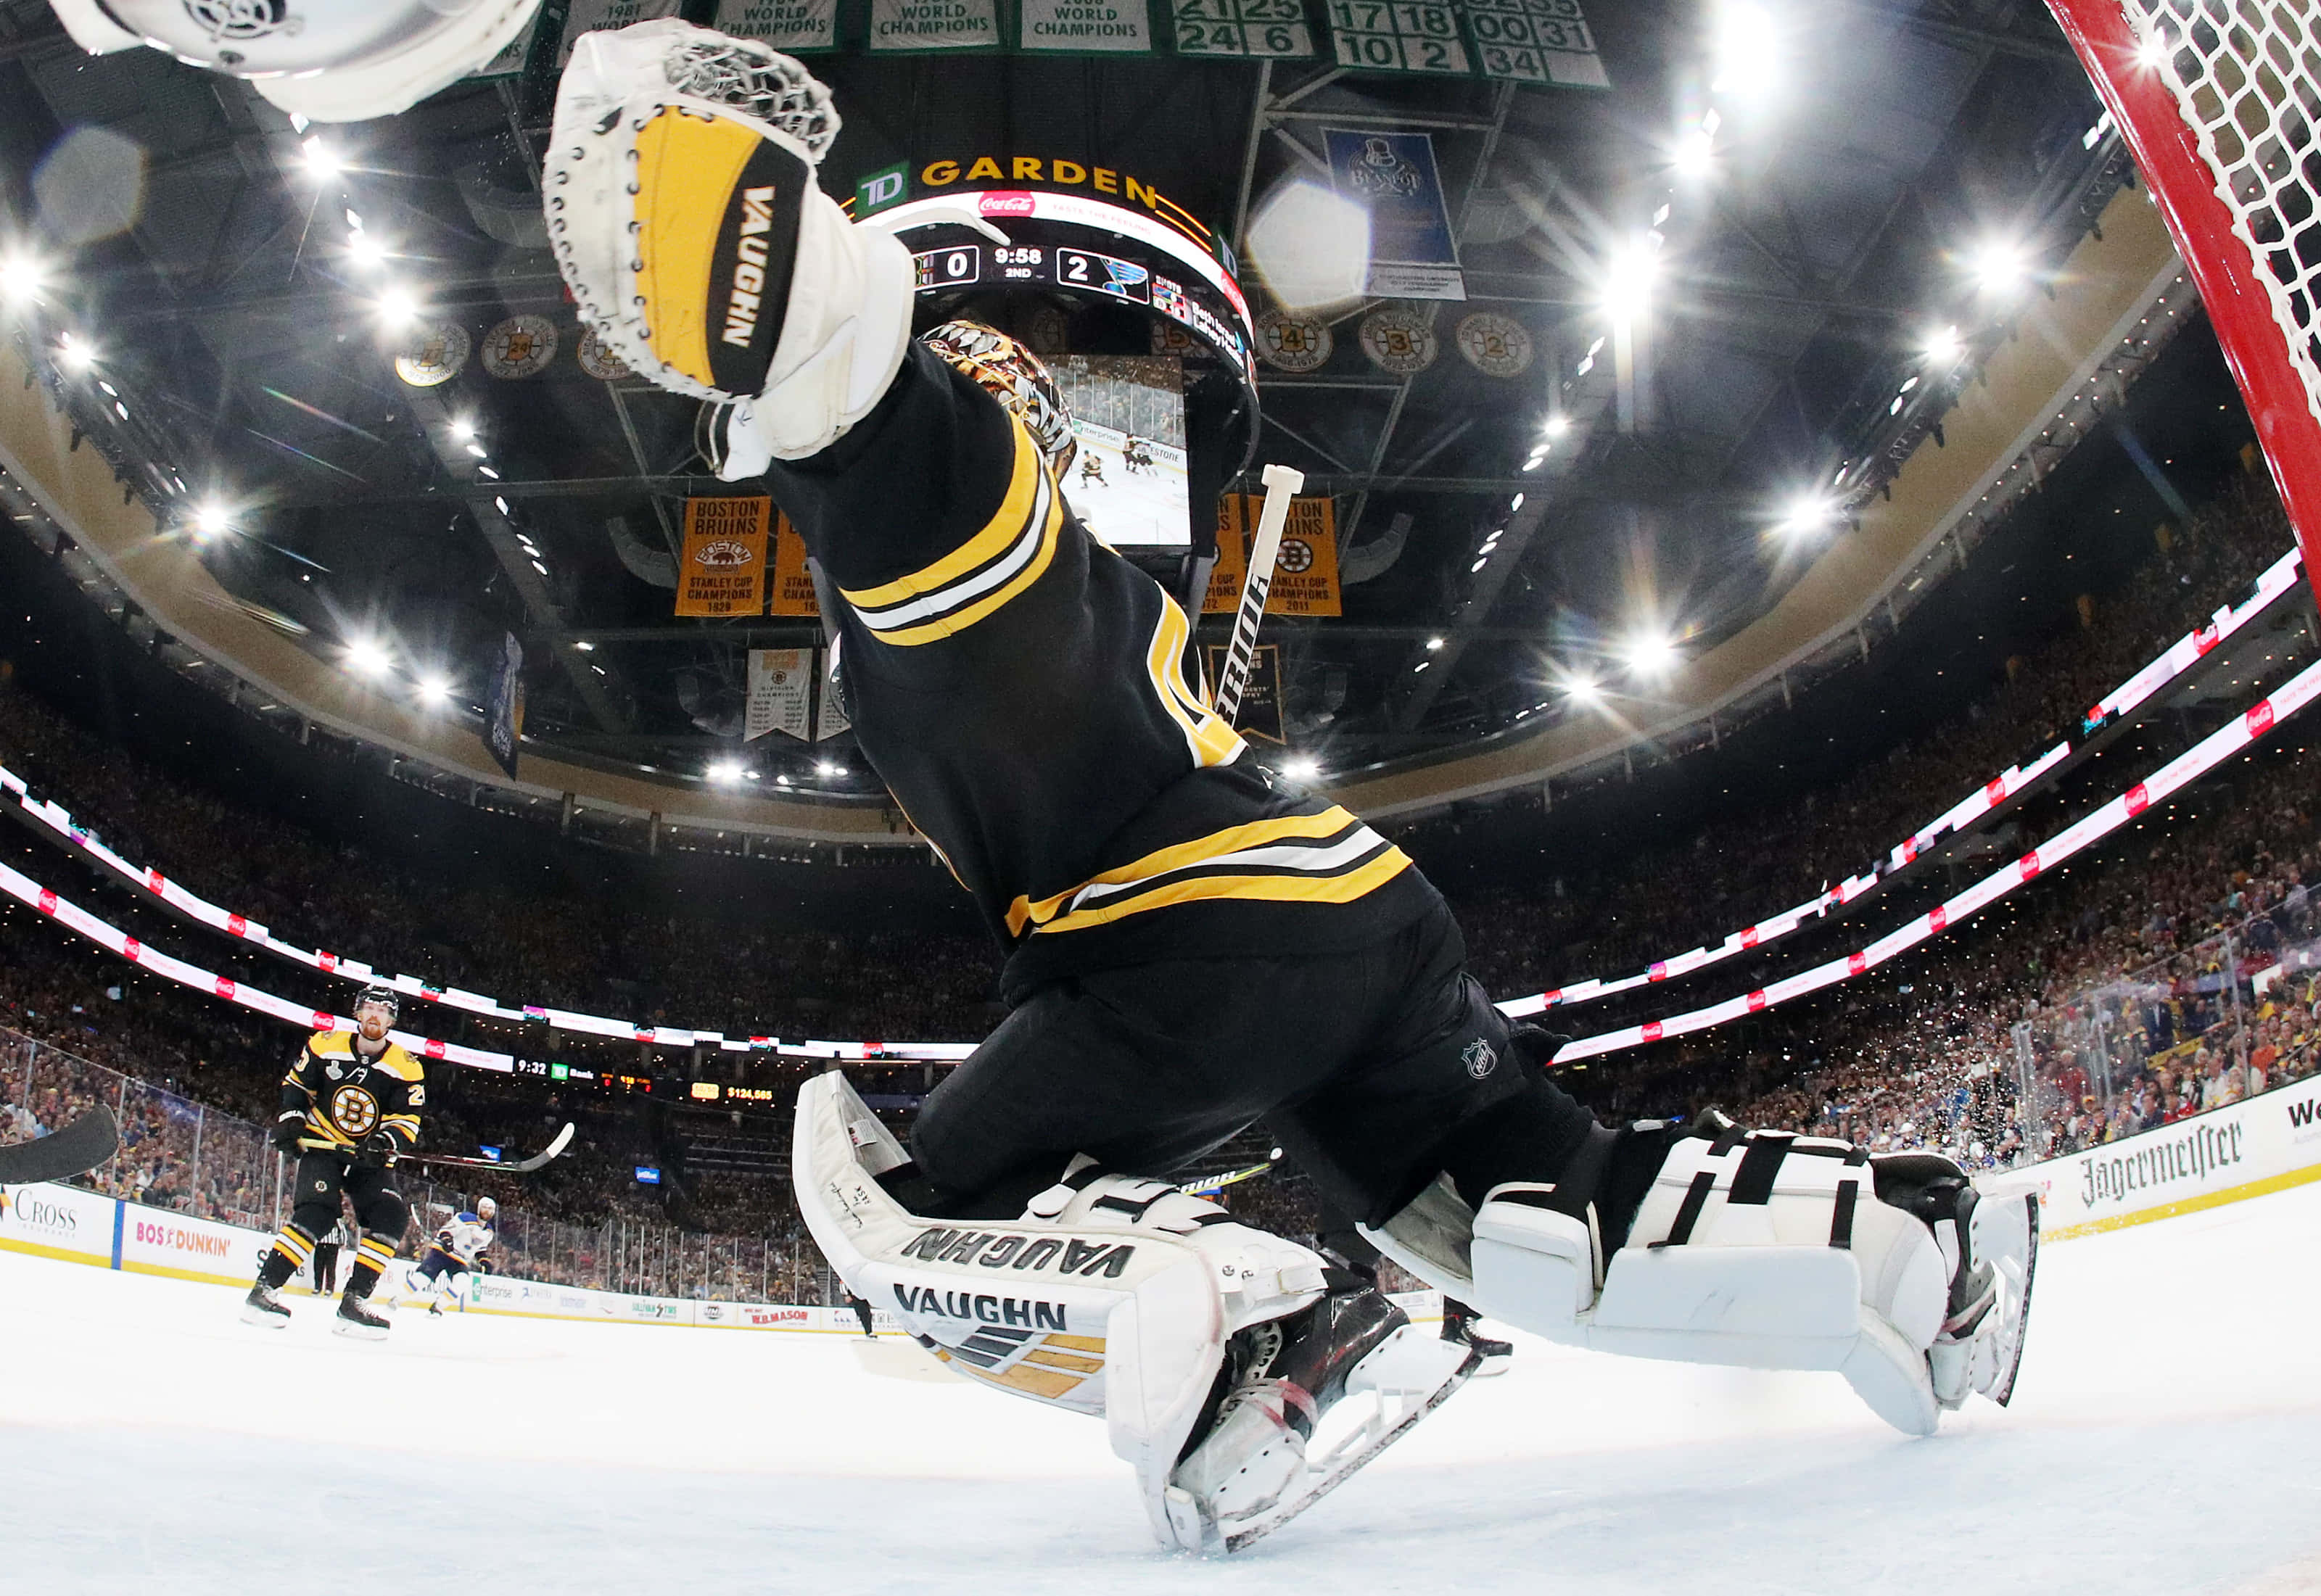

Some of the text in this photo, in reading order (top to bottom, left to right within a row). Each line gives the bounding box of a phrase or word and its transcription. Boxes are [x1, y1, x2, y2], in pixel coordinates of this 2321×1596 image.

[607, 5, 641, 19] 1981
[744, 7, 808, 21] WORLD
[902, 4, 966, 20] WORLD
[1055, 7, 1118, 21] WORLD
[1334, 4, 1382, 29] 17
[1401, 6, 1450, 35] 18
[880, 17, 989, 36] CHAMPIONS
[1034, 22, 1137, 37] CHAMPIONS
[1474, 14, 1528, 41] 00
[1542, 20, 1588, 48] 31
[1179, 24, 1238, 51] 24
[1266, 27, 1294, 52] 6
[1342, 36, 1393, 65] 10
[1421, 42, 1451, 69] 2
[1487, 48, 1539, 76] 34
[861, 157, 1157, 210] TD GARDEN
[947, 252, 968, 277] 0
[994, 247, 1042, 264] 9:58
[721, 185, 775, 349] VAUGHN
[1005, 268, 1031, 278] 2ND
[1068, 255, 1088, 281] 2
[1285, 328, 1301, 344] 4
[1390, 333, 1407, 350] 3
[1487, 336, 1504, 353] 2
[510, 342, 529, 353] 24
[697, 500, 759, 518] BOSTON
[695, 518, 757, 535] BRUINS
[1284, 518, 1324, 535] UINS
[695, 539, 754, 564] BOSTON
[690, 576, 753, 587] STANLEY CUP
[1206, 585, 1237, 597] PIONS
[1271, 576, 1328, 588] TANLEY CUP
[688, 589, 753, 600] CHAMPIONS
[1287, 601, 1309, 611] 2011
[518, 1059, 547, 1075] 9:32
[569, 1068, 594, 1080] Bank
[408, 1083, 426, 1107] 2
[1180, 1170, 1236, 1194] RIOR
[15, 1188, 78, 1231] CROSS
[136, 1222, 231, 1258] BOS DUNKIN'
[900, 1227, 1137, 1279] VAUGHN
[474, 1282, 514, 1299] enterprise
[893, 1283, 1068, 1332] VAUGHN
